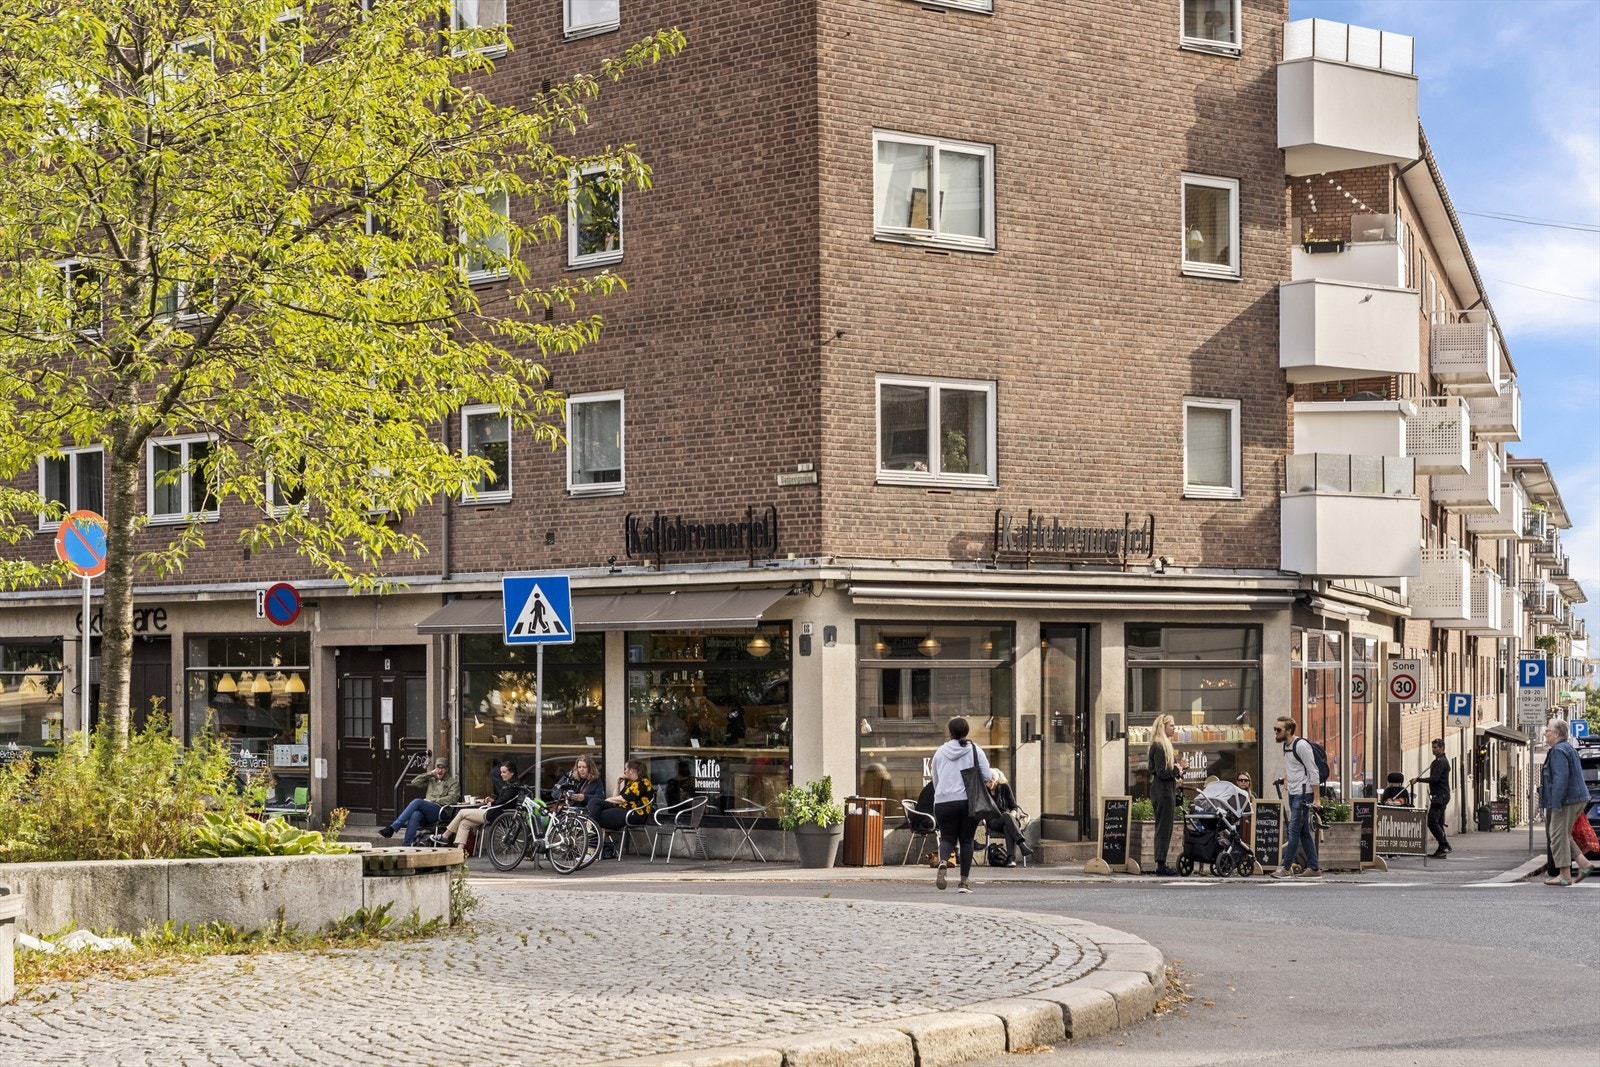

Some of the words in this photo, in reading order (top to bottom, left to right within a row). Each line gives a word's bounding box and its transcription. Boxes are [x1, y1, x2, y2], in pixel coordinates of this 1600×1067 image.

[630, 510, 772, 554] Kaffebrenneriet
[1001, 513, 1149, 554] Kaffebrenneriet
[75, 607, 103, 633] ekt
[132, 607, 168, 631] are
[1392, 661, 1415, 670] Sone
[1525, 662, 1540, 684] P
[1395, 680, 1412, 693] 30
[1454, 696, 1467, 713] P
[1575, 723, 1585, 738] P
[695, 759, 720, 779] Kaffe
[1183, 769, 1207, 779] renneriet
[695, 778, 720, 789] brenneriet
[1491, 814, 1508, 822] 105,-
[1376, 815, 1422, 838] affebrenneriet
[1390, 840, 1398, 848] FOR
[1409, 841, 1422, 849] KAFFE
